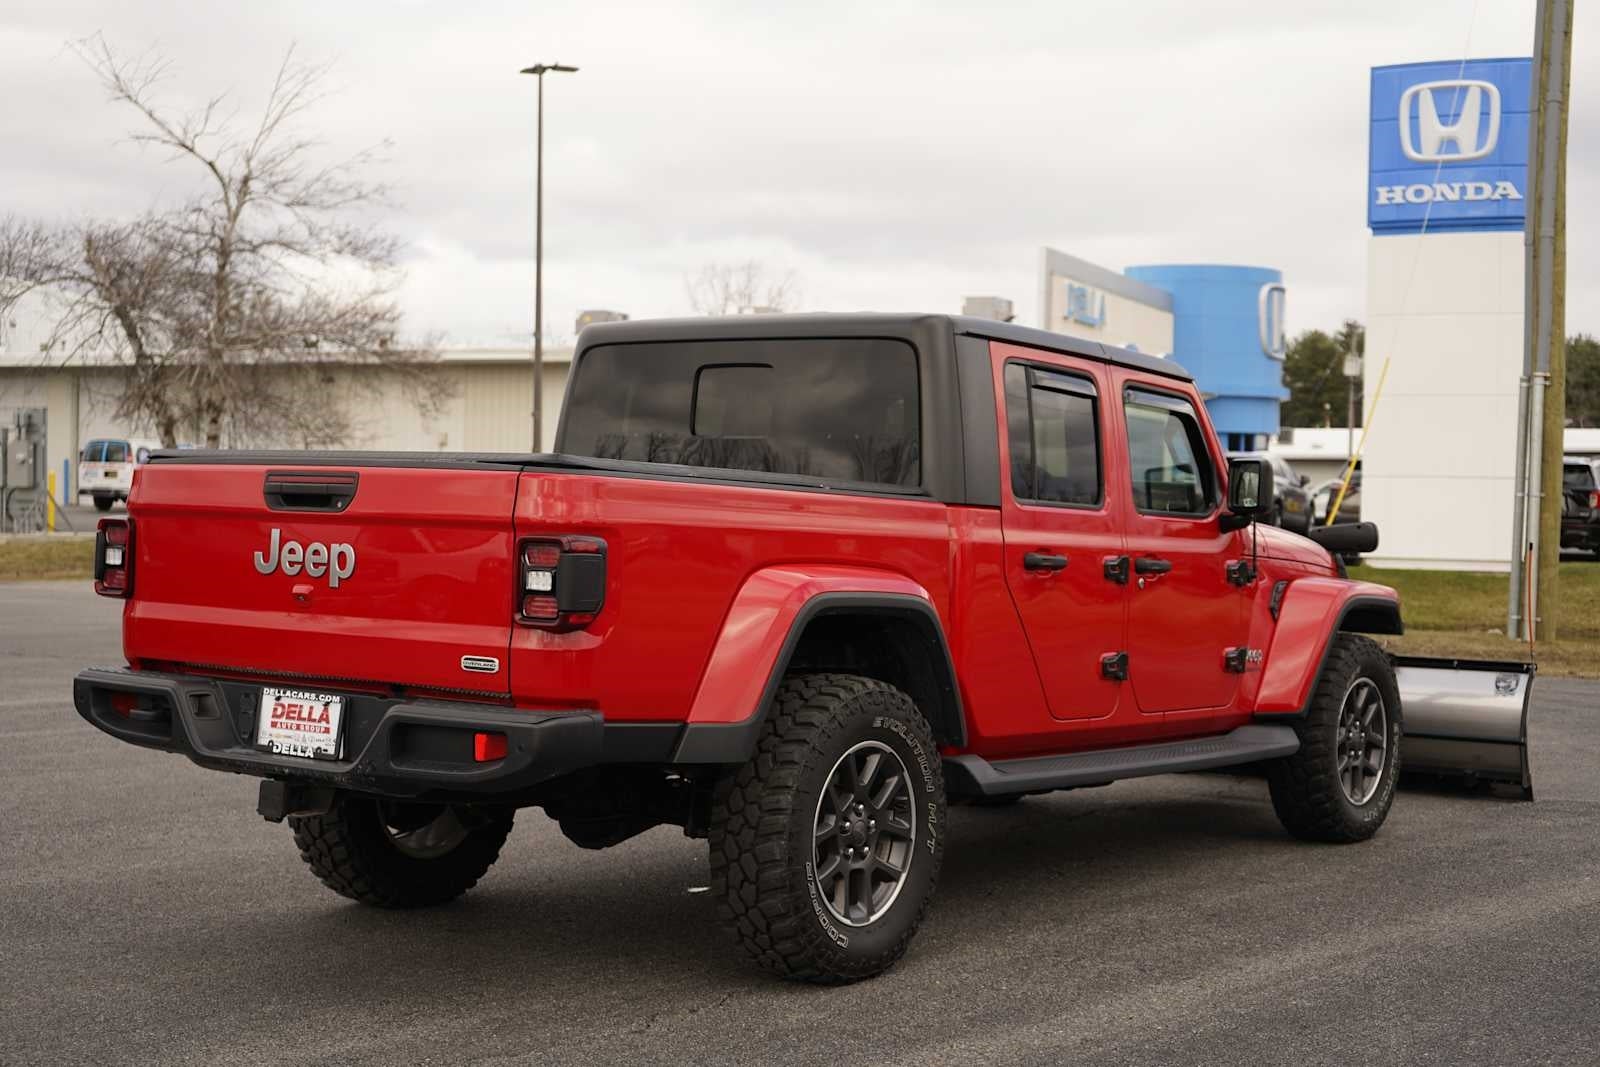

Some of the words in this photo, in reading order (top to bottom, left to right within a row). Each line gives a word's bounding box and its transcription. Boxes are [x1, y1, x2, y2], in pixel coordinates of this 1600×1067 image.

[1376, 181, 1523, 205] HONDA
[254, 528, 355, 588] Jeep
[263, 687, 341, 703] DELLACARS.COM
[271, 702, 330, 724] DELLA
[276, 721, 298, 731] AUTO
[300, 724, 327, 734] GROUP
[272, 743, 315, 758] DELLA
[805, 861, 849, 949] COOPER
